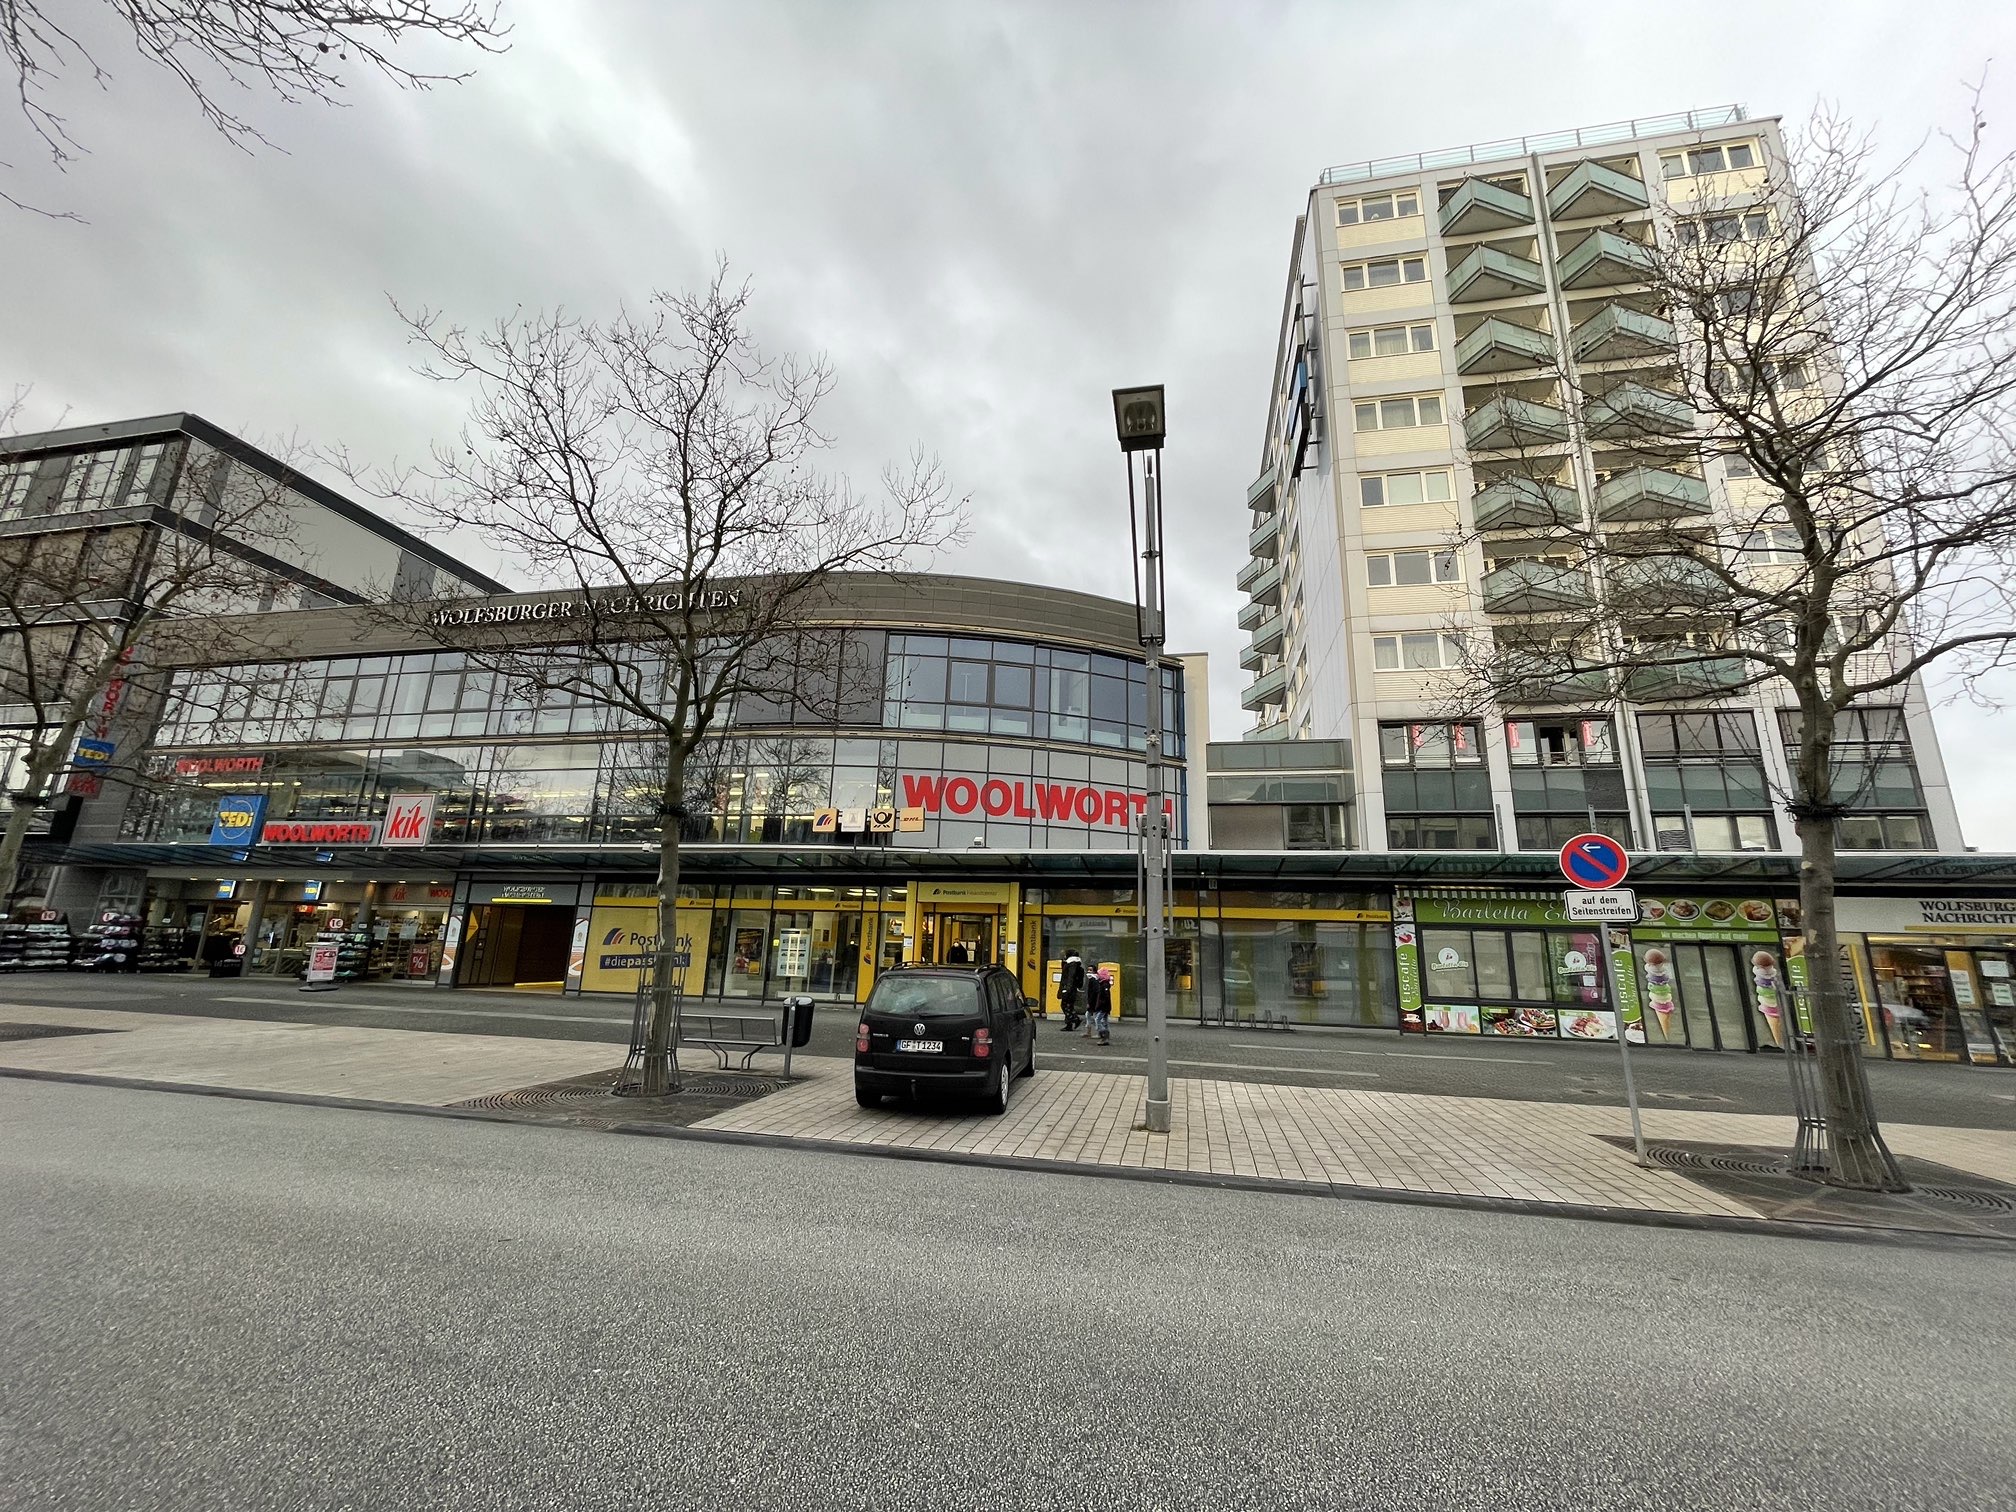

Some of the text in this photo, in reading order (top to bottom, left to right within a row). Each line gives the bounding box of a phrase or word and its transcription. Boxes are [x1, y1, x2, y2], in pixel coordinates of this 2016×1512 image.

[433, 601, 572, 626] WOLFSBURGER
[219, 811, 254, 828] TEDi
[264, 824, 374, 843] WOOLWORTH
[1582, 896, 1618, 905] auf dem
[1433, 900, 1529, 920] Barletta
[1572, 907, 1632, 916] Seitenstreifen
[630, 933, 693, 947] Postnk
[866, 916, 874, 950] Postbank
[1030, 920, 1038, 956] Postbank
[901, 1041, 911, 1049] GF
